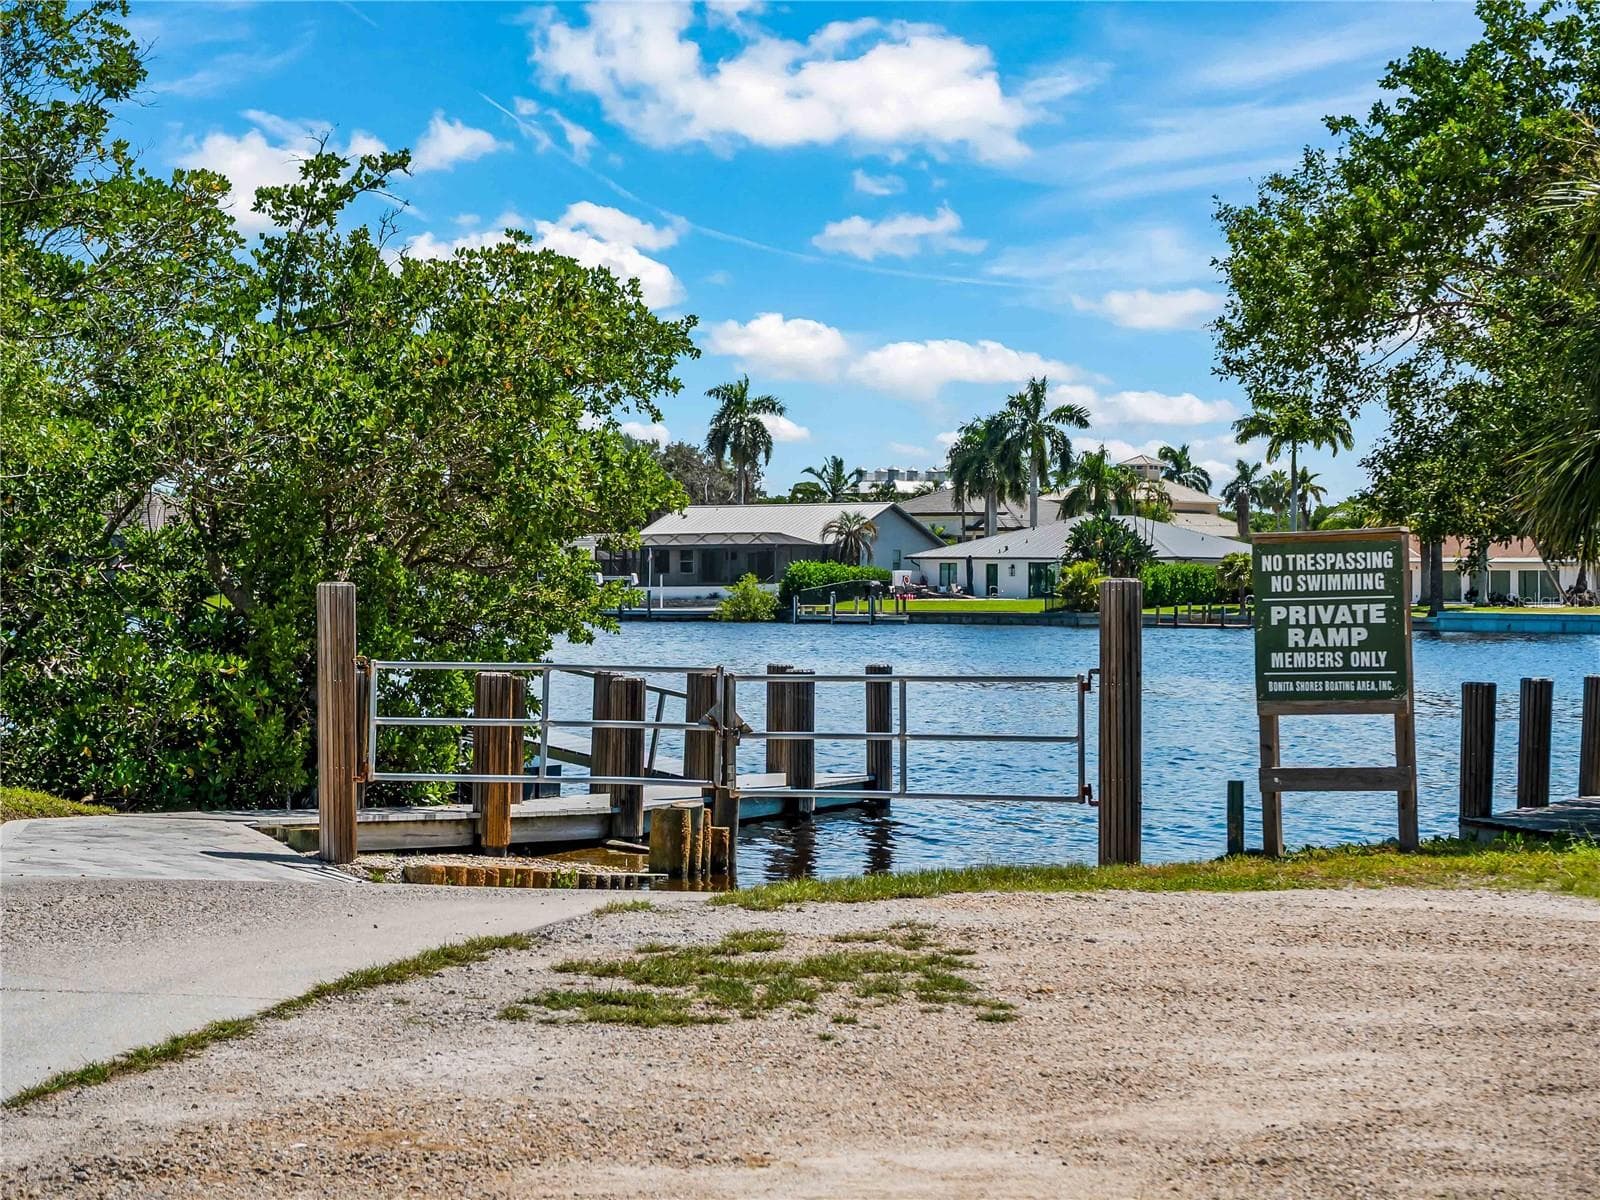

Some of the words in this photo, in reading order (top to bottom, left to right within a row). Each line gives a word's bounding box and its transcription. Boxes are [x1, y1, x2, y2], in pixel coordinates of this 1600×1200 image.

[1261, 554, 1283, 572] NO
[1285, 551, 1393, 570] TRESPASSING
[1271, 575, 1293, 593] NO
[1297, 573, 1385, 592] SWIMMING
[1270, 603, 1387, 625] PRIVATE
[1287, 627, 1368, 648] RAMP
[1271, 651, 1344, 668] MEMBERS
[1351, 651, 1387, 667] ONLY
[1268, 680, 1294, 692] BONITA
[1295, 680, 1323, 692] SHORES
[1324, 680, 1355, 691] BOATING
[1356, 680, 1378, 692] AREA,
[1378, 680, 1394, 691] INC.
